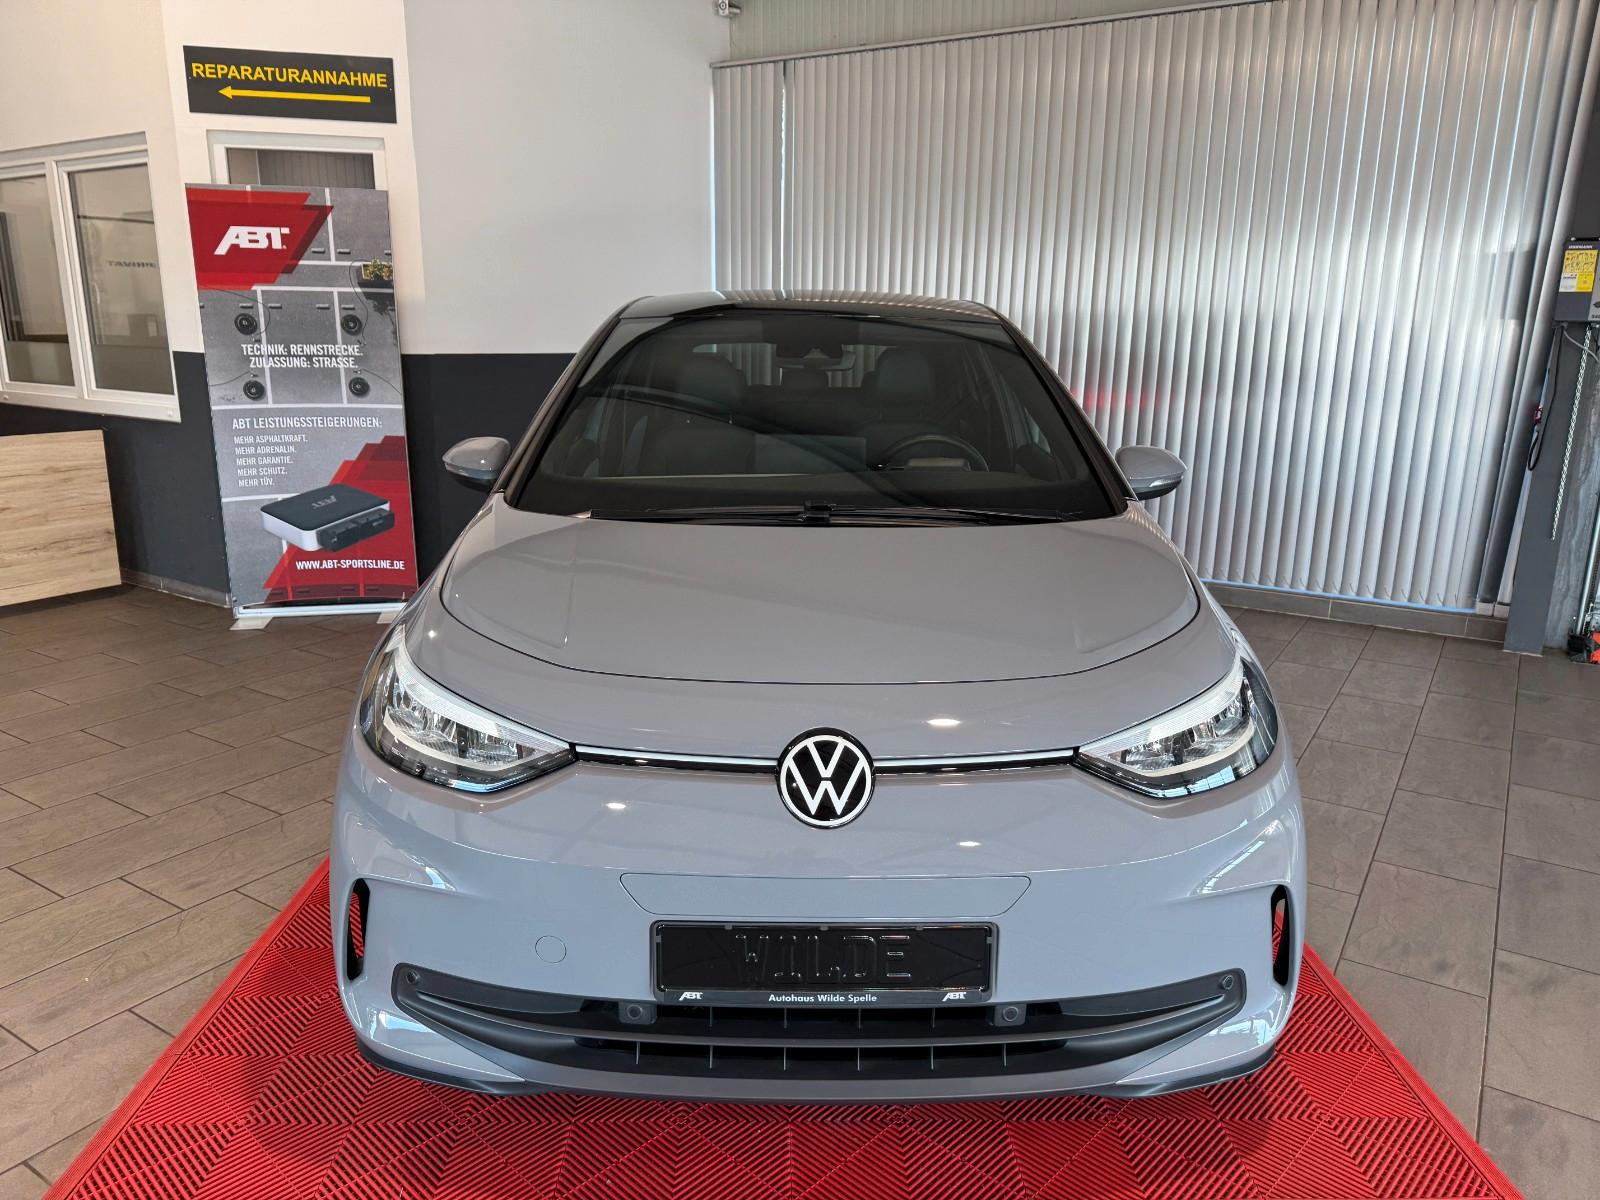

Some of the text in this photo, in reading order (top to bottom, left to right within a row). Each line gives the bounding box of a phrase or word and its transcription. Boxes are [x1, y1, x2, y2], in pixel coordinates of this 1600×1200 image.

[191, 62, 388, 88] REPARATURANNAHME
[241, 344, 364, 356] TECHNIK: RENNSTRECKE.
[249, 356, 359, 369] ZULASSUNG: STRASSE.
[232, 416, 383, 430] ABT LEISTUNGSSTEIGERUNGEN:
[233, 434, 308, 444] MEHR ASPHALTKRAFT.
[235, 445, 297, 455] MEHR ADRENALIN.
[236, 456, 294, 466] MEHR GARANTIE.
[237, 466, 288, 477] MEHR SCHUTZ.
[238, 476, 276, 488] MEHR TÜV.
[295, 559, 405, 570] WWW.ABT-SPORTSLINE.DE
[679, 991, 703, 1001] ABT
[768, 993, 877, 1003] Autohaus Wilde Spelle
[942, 991, 967, 1002] ABT
